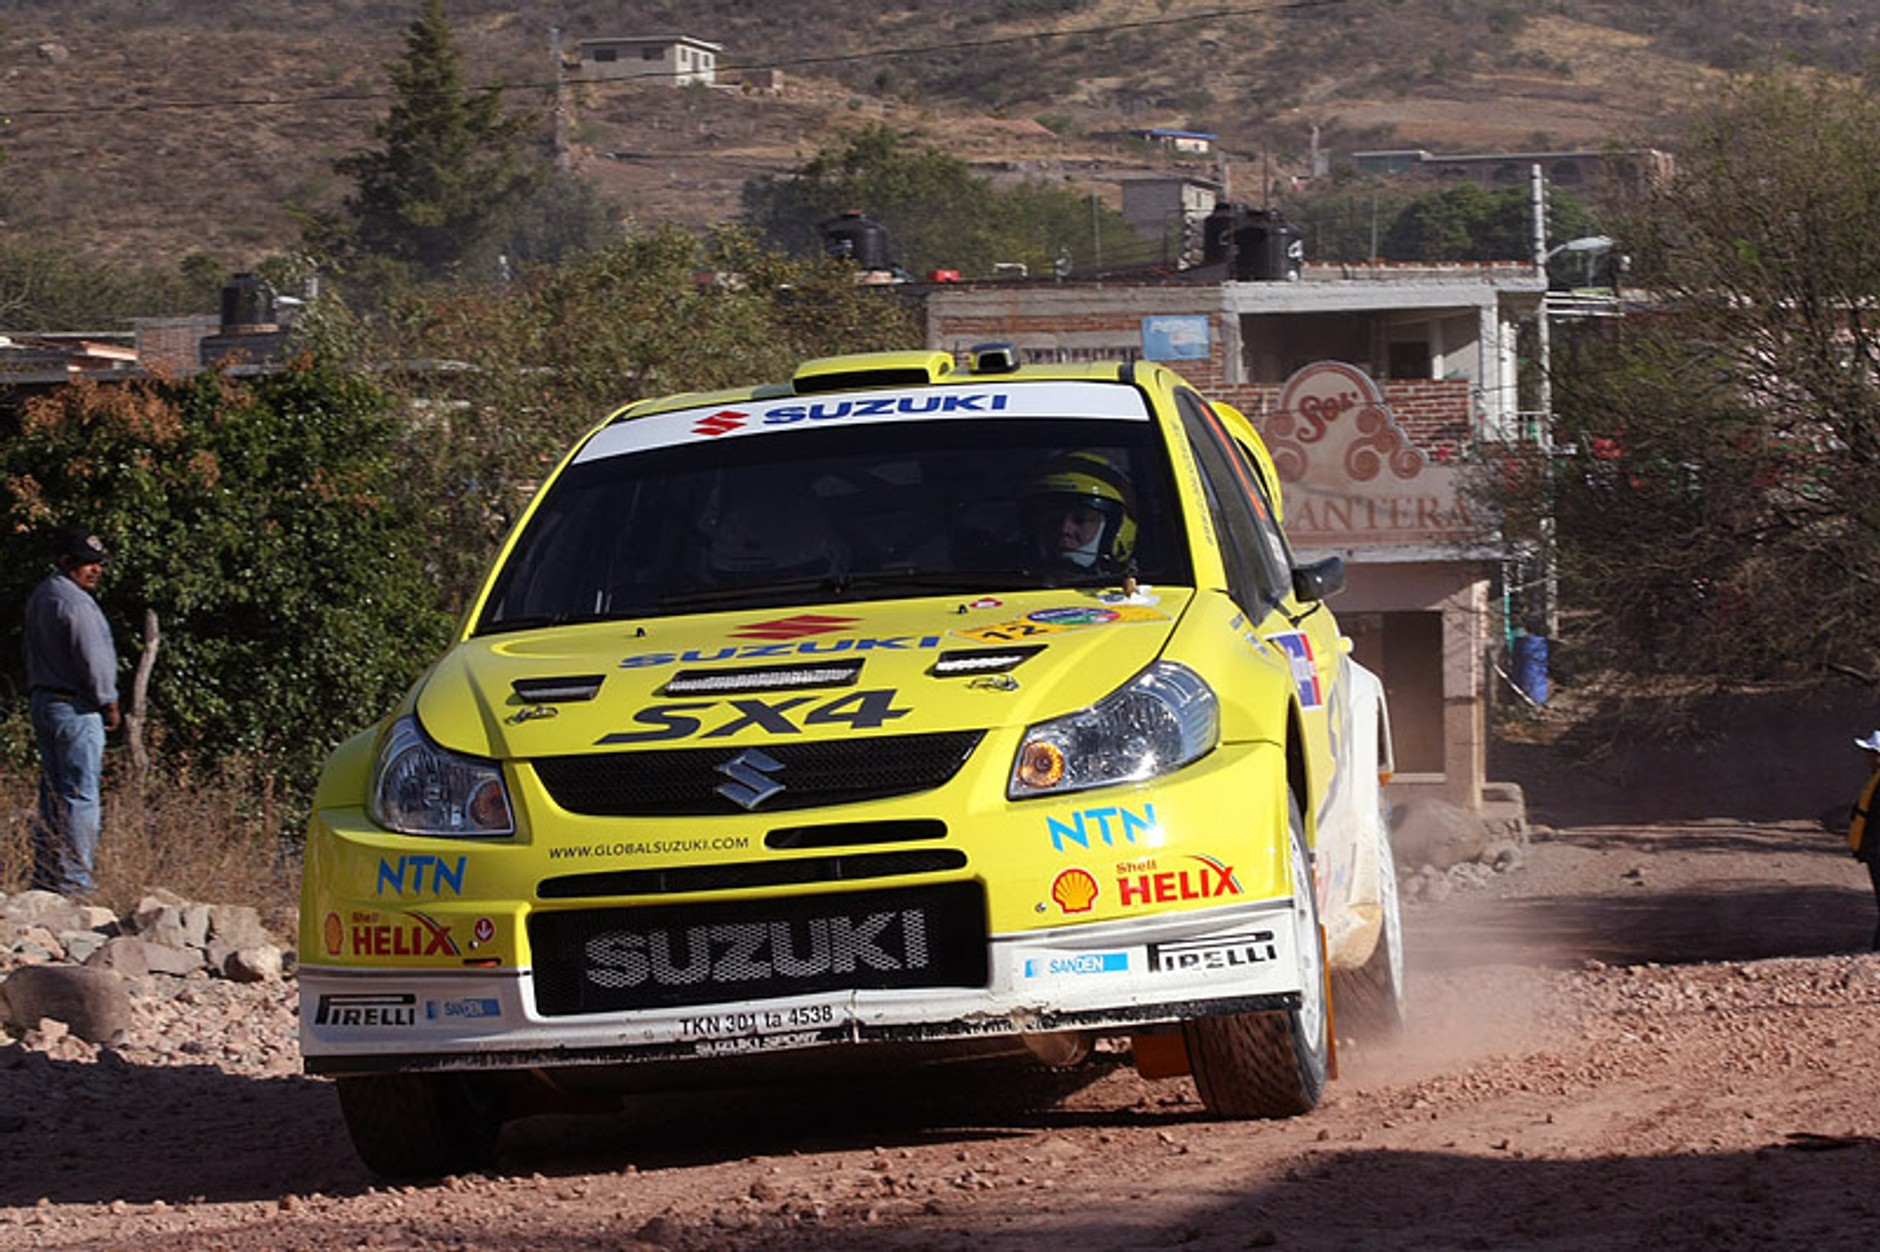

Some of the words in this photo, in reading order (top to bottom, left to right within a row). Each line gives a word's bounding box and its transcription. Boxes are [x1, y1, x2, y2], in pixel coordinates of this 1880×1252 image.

[763, 394, 1007, 425] SUZUKI
[617, 636, 941, 669] SUZUKI
[592, 688, 915, 746] SX4
[1046, 803, 1161, 853] NTN
[549, 836, 750, 859] WWW.GLOBALSUZUKI.COM
[376, 854, 468, 897] NTN
[1116, 860, 1157, 874] Shell
[1117, 864, 1240, 906] HELIX
[352, 922, 457, 956] HELIX
[585, 908, 929, 987] SUZUKI
[1146, 930, 1278, 974] PIRELLI
[1050, 955, 1104, 975] SANDEN
[314, 993, 417, 1026] PIRELLI
[680, 1018, 721, 1035] TKN
[726, 1012, 756, 1033] 301
[764, 1011, 781, 1028] ta
[788, 1005, 834, 1027] 4538
